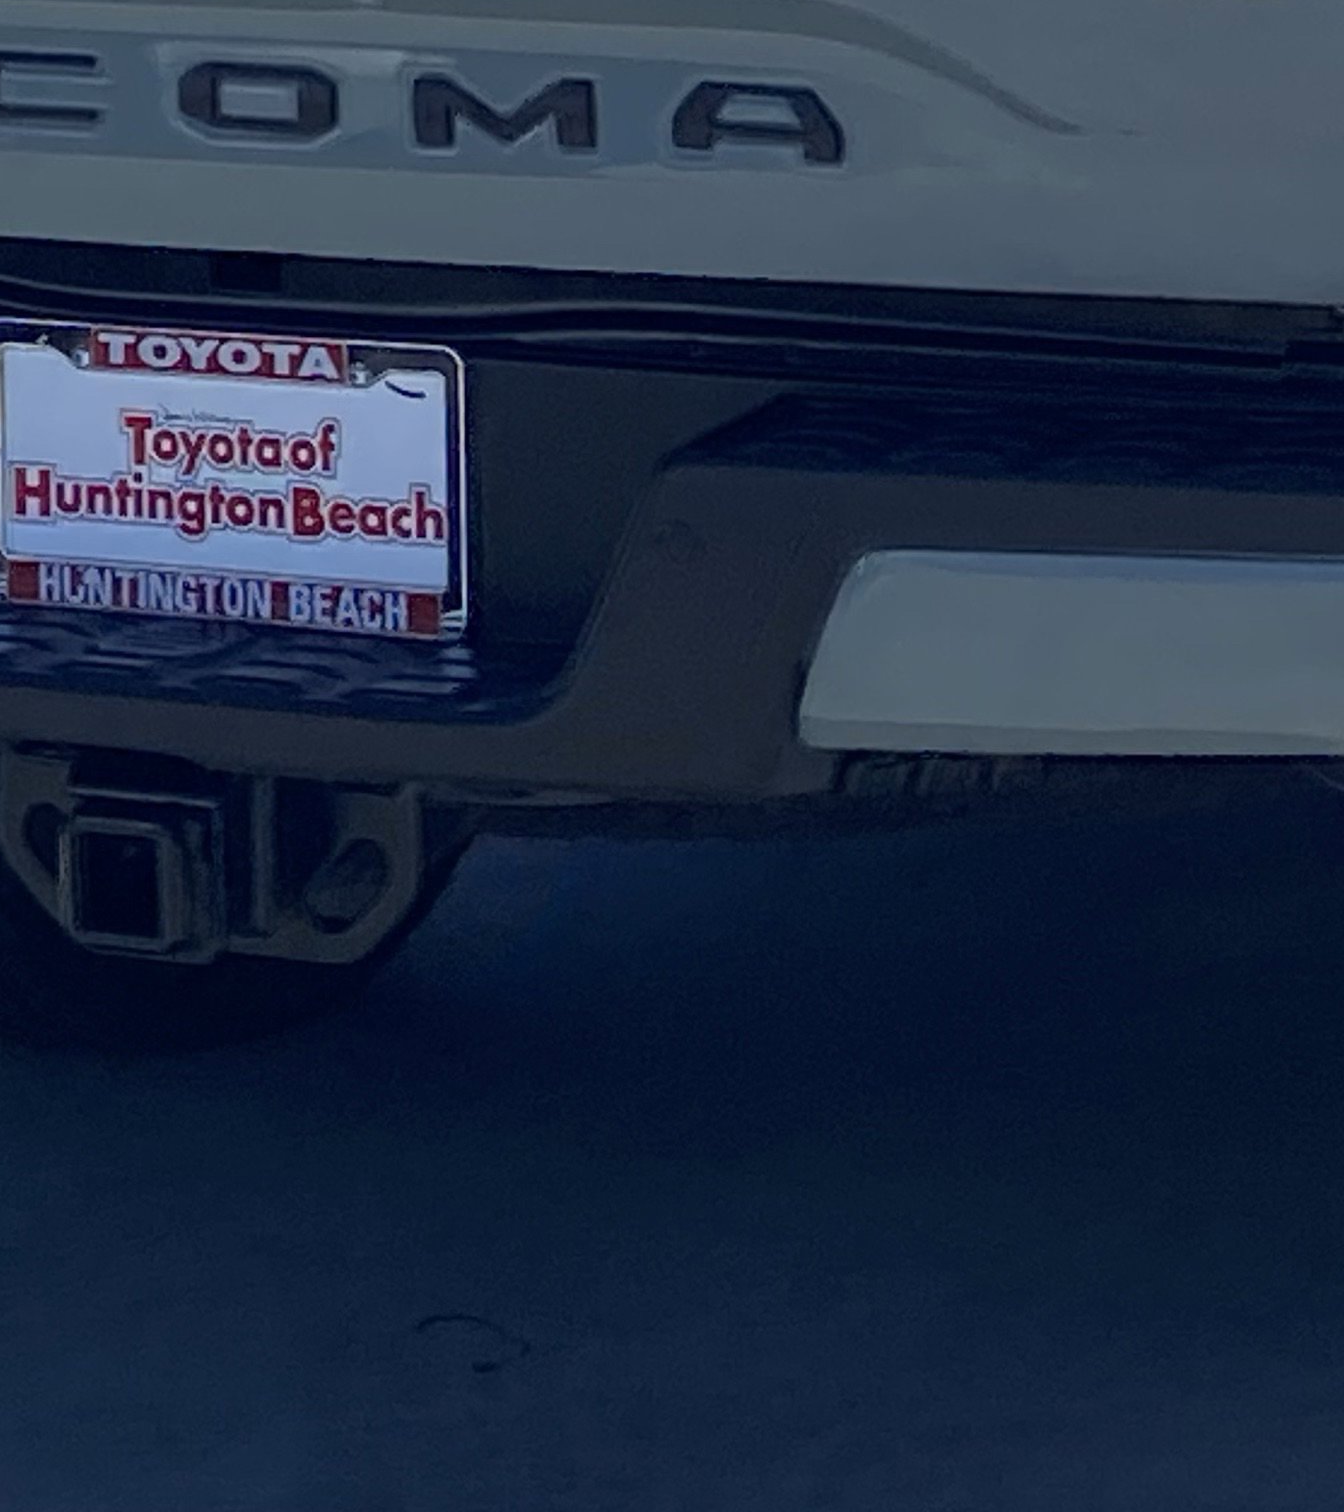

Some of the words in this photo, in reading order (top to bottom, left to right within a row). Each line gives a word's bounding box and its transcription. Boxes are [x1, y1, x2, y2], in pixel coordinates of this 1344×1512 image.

[96, 331, 342, 380] TOYOTA
[13, 466, 286, 535] Huntington
[292, 486, 445, 540] Beach
[38, 560, 272, 620] HUNTINGTON
[289, 581, 409, 632] BEACH
